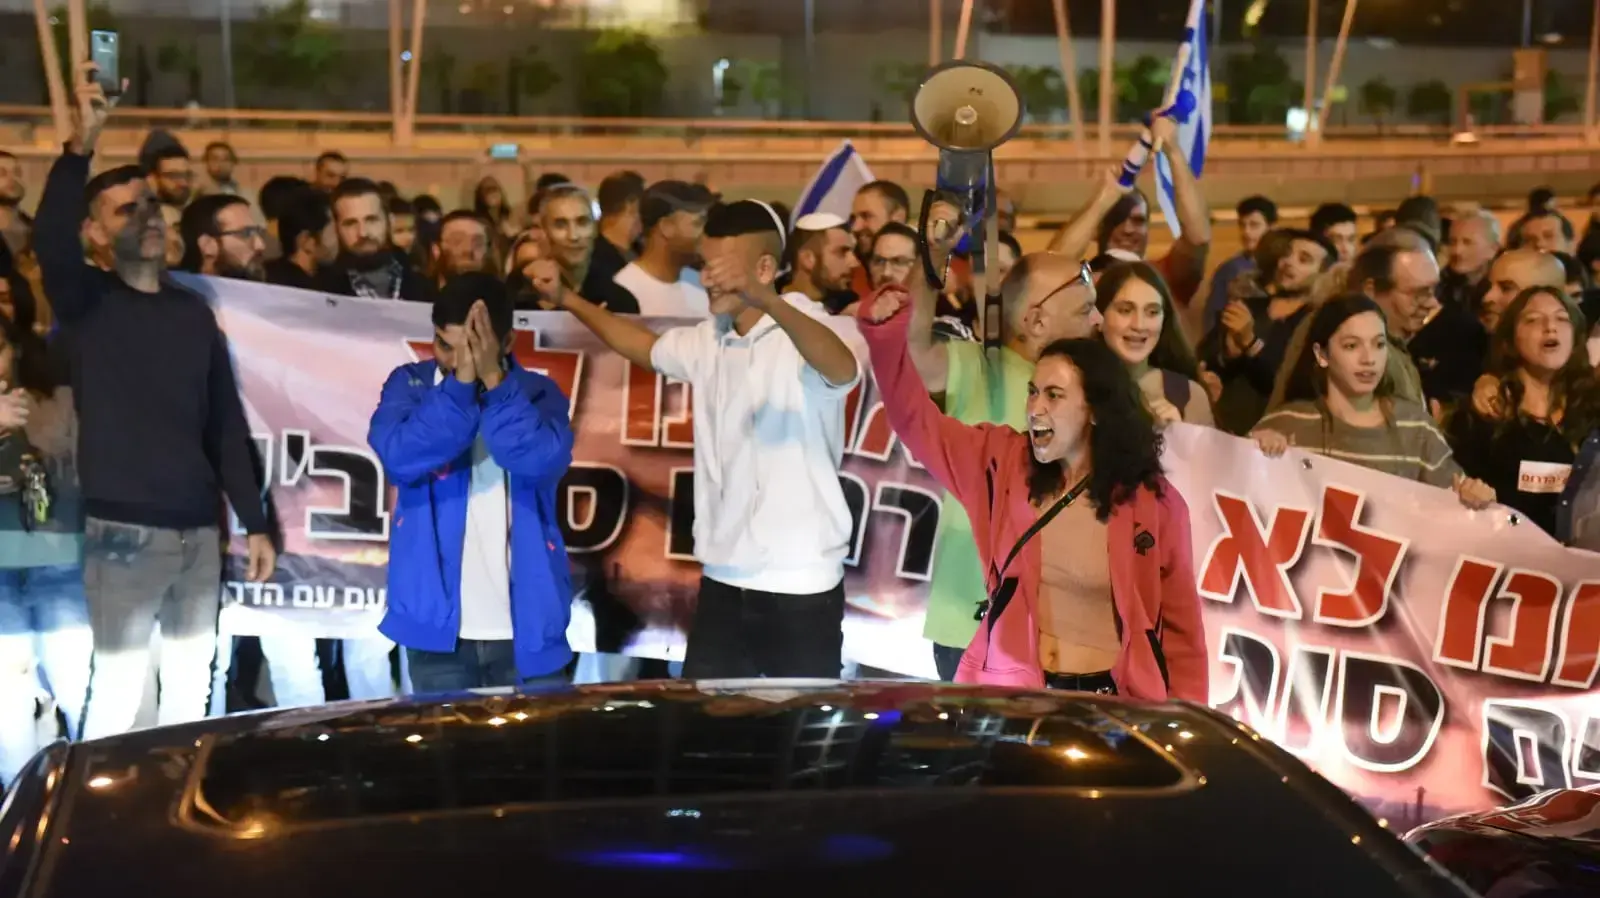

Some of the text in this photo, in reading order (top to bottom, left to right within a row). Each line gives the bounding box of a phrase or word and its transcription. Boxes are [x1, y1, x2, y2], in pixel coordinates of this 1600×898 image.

[293, 584, 335, 608] עם
[1200, 485, 1411, 627] לא
[344, 586, 388, 611] עם
[1209, 627, 1445, 773] סוג
